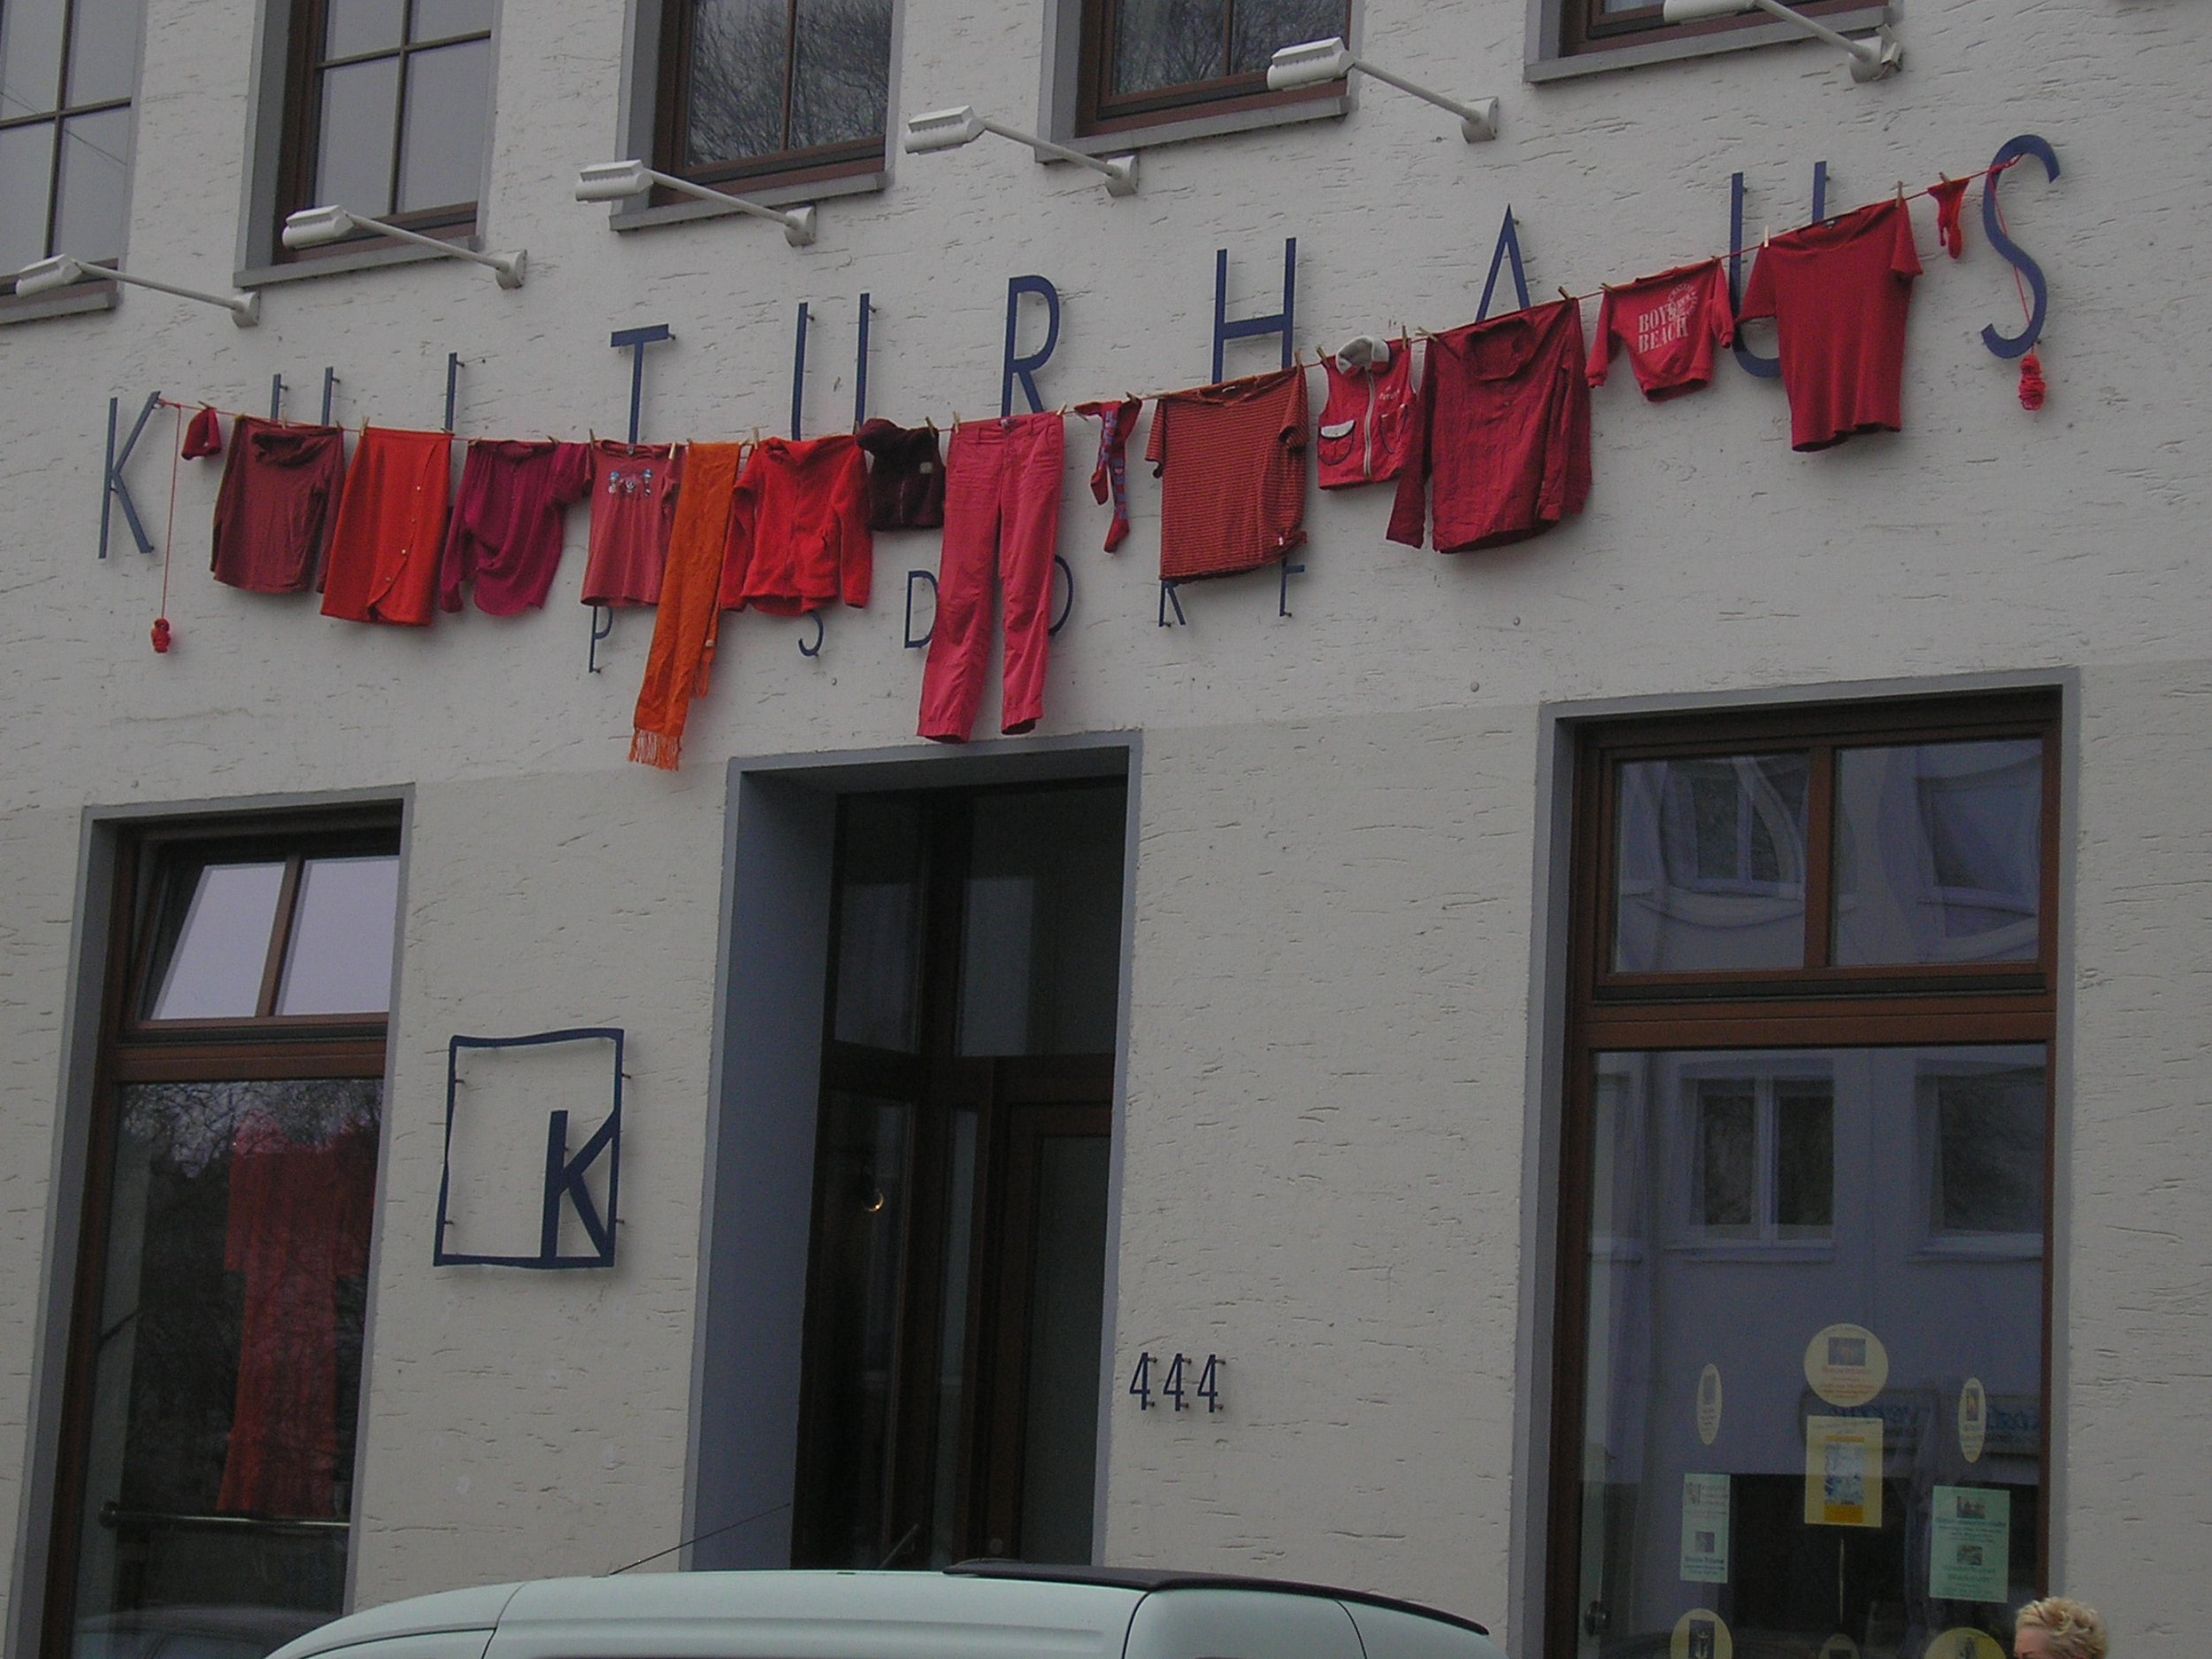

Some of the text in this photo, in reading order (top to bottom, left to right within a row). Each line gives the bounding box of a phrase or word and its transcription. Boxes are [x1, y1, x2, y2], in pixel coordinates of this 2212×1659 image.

[1639, 317, 1688, 354] BEACH
[540, 1110, 621, 1269] K
[1129, 1352, 1218, 1413] 444
